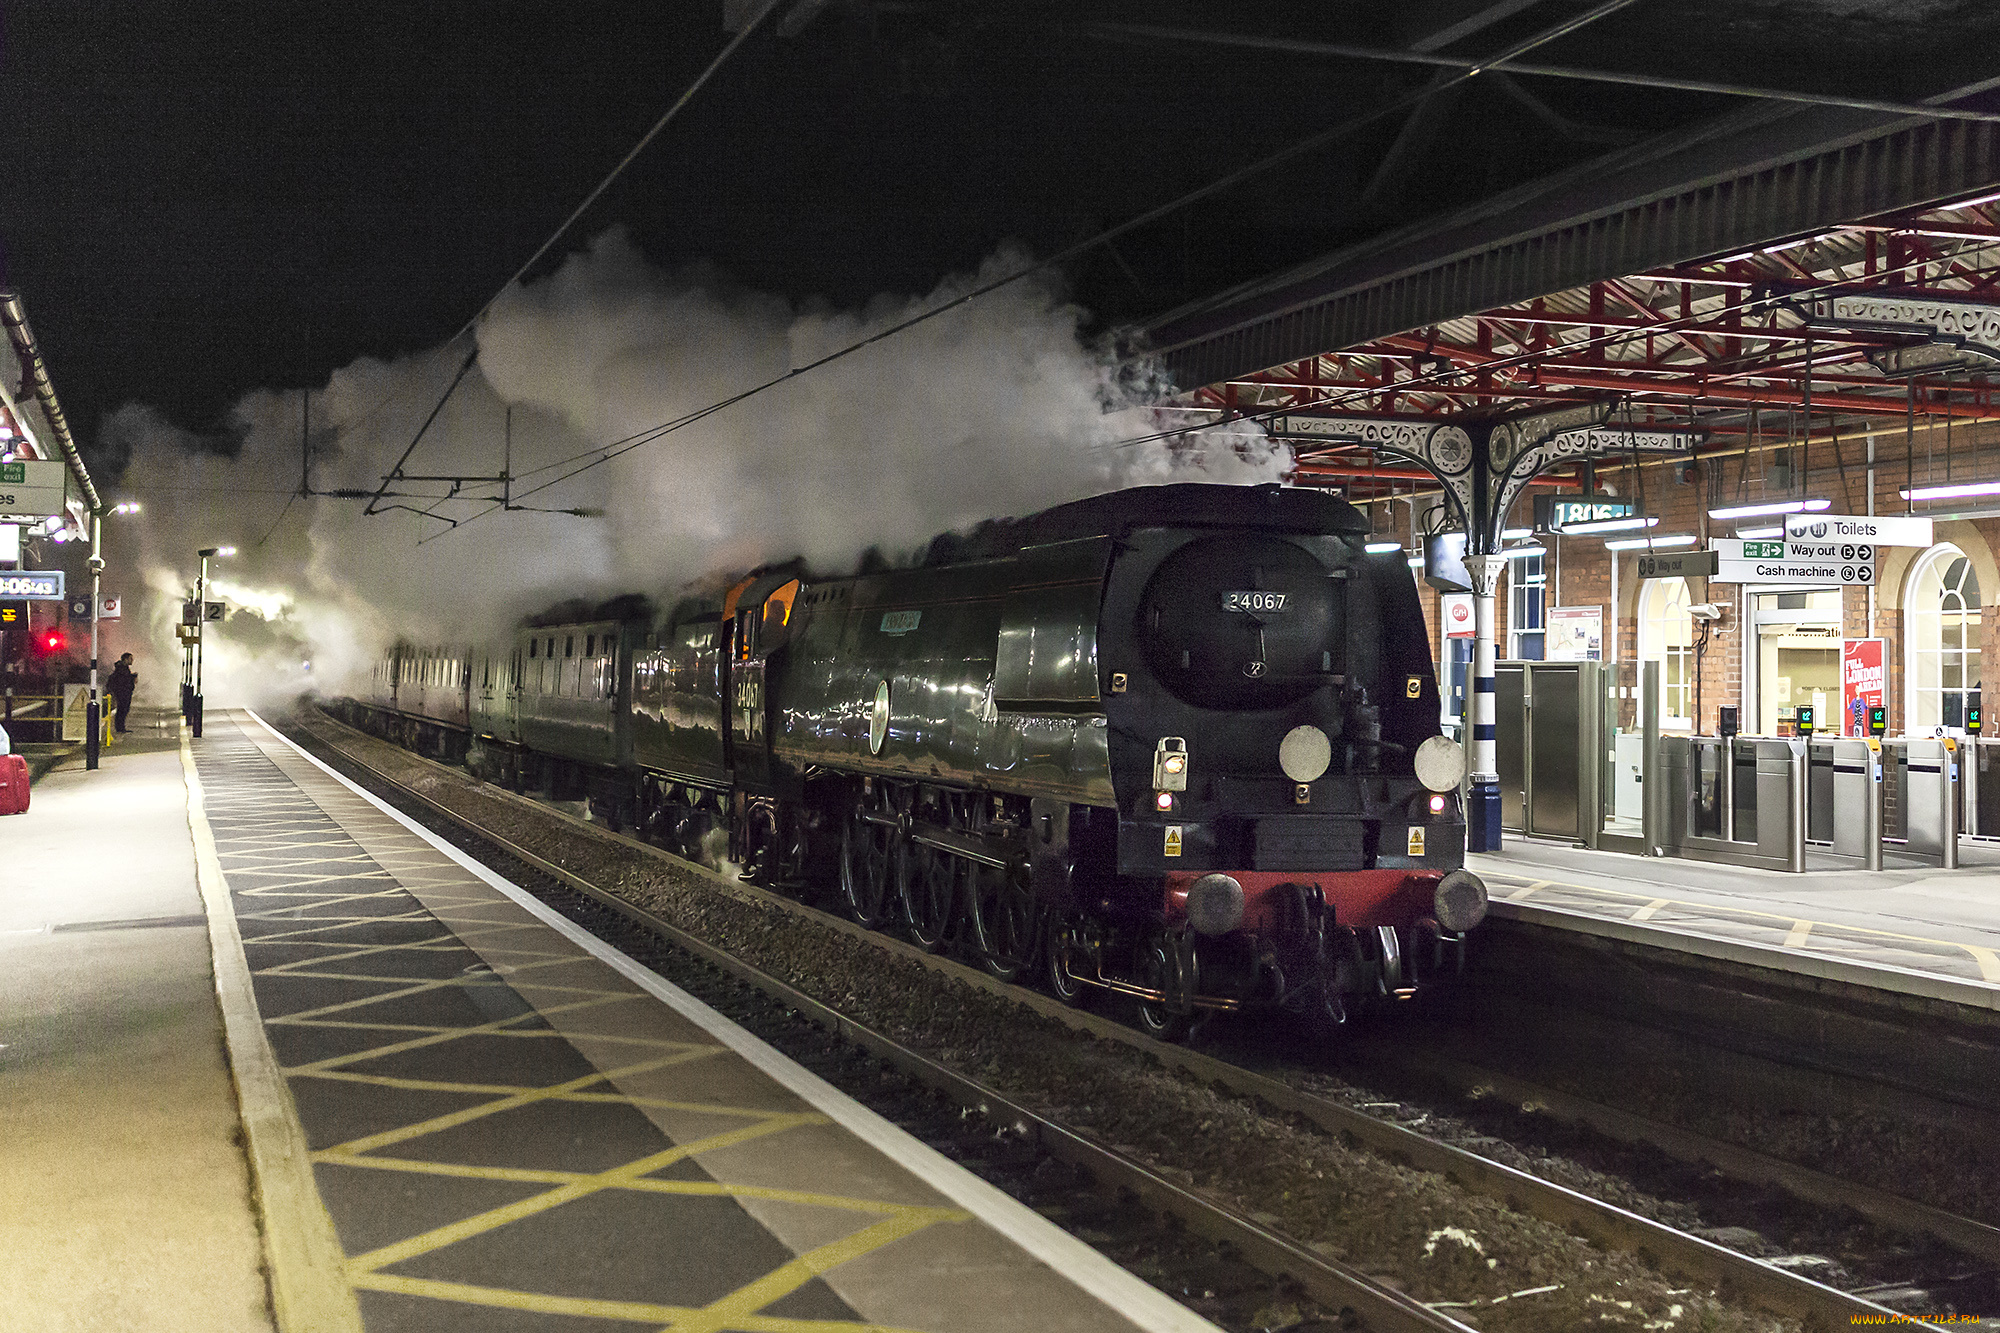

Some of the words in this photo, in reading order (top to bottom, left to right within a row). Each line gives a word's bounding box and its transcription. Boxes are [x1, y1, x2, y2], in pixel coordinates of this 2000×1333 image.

[1834, 522, 1877, 536] Toilets
[1790, 544, 1815, 557] Way
[1817, 545, 1836, 556] out
[1658, 560, 1670, 572] Way
[1671, 559, 1682, 570] out
[1756, 564, 1785, 576] Cash
[1788, 566, 1836, 577] machine
[1230, 594, 1286, 609] 34067
[209, 604, 221, 620] 2
[1845, 658, 1864, 670] FULL
[1846, 665, 1882, 684] LONDON
[1859, 679, 1882, 693] AHEAD
[737, 682, 758, 708] 34067
